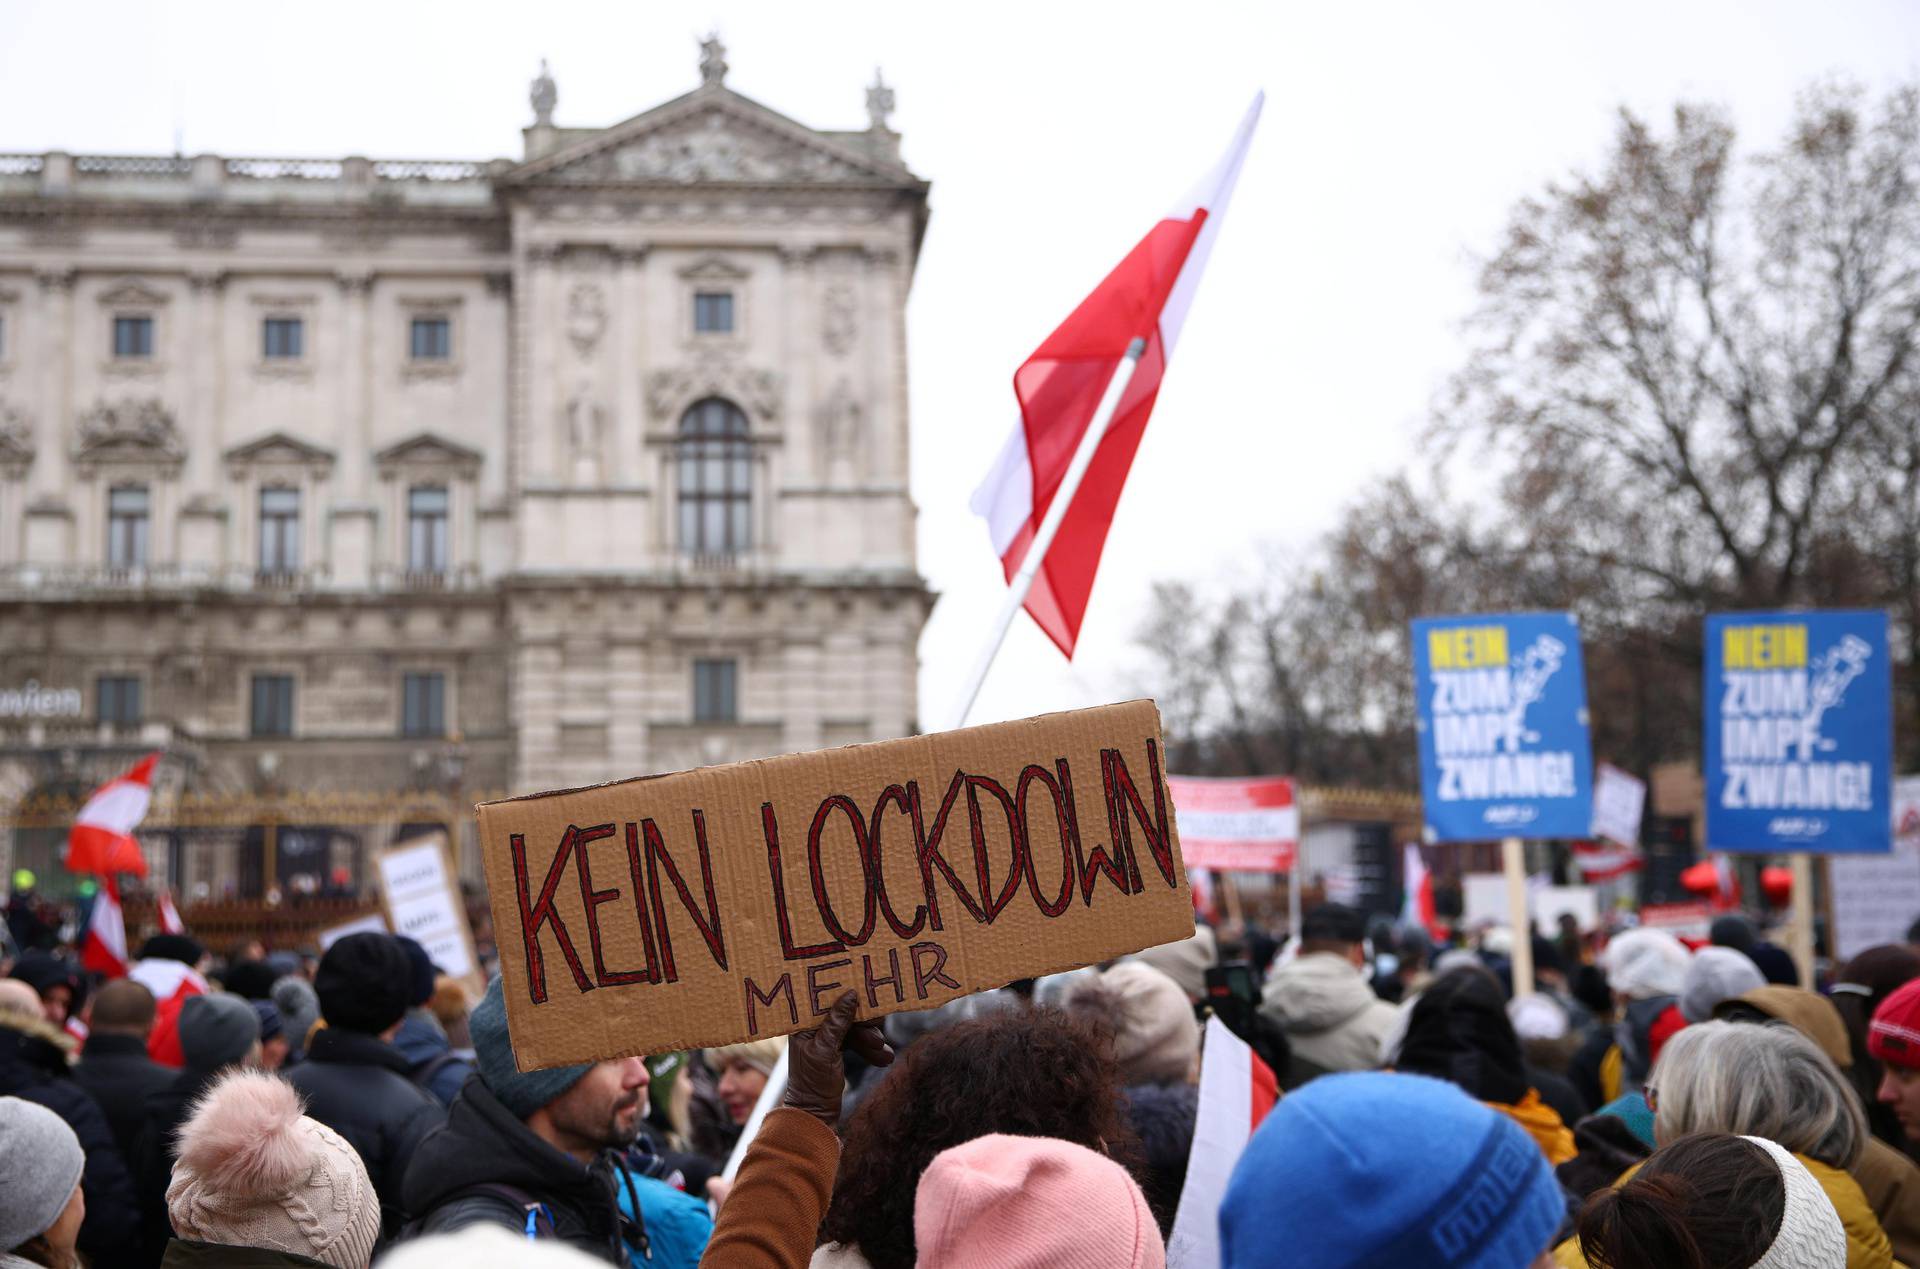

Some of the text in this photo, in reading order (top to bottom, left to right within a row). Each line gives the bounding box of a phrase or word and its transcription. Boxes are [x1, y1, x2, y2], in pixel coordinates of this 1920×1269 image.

[1429, 625, 1508, 671] NEIN
[1723, 624, 1808, 671] NEIN
[1431, 668, 1510, 716] ZUM
[1721, 670, 1809, 716] ZUM
[1433, 713, 1541, 756] IMPF-
[1721, 718, 1837, 761] IMPF-
[1436, 752, 1576, 801] ZWANG!
[1721, 761, 1873, 810] ZWANG!
[509, 738, 1177, 1004] KEIN LOCKDOWN
[743, 942, 961, 1036] MEHR
